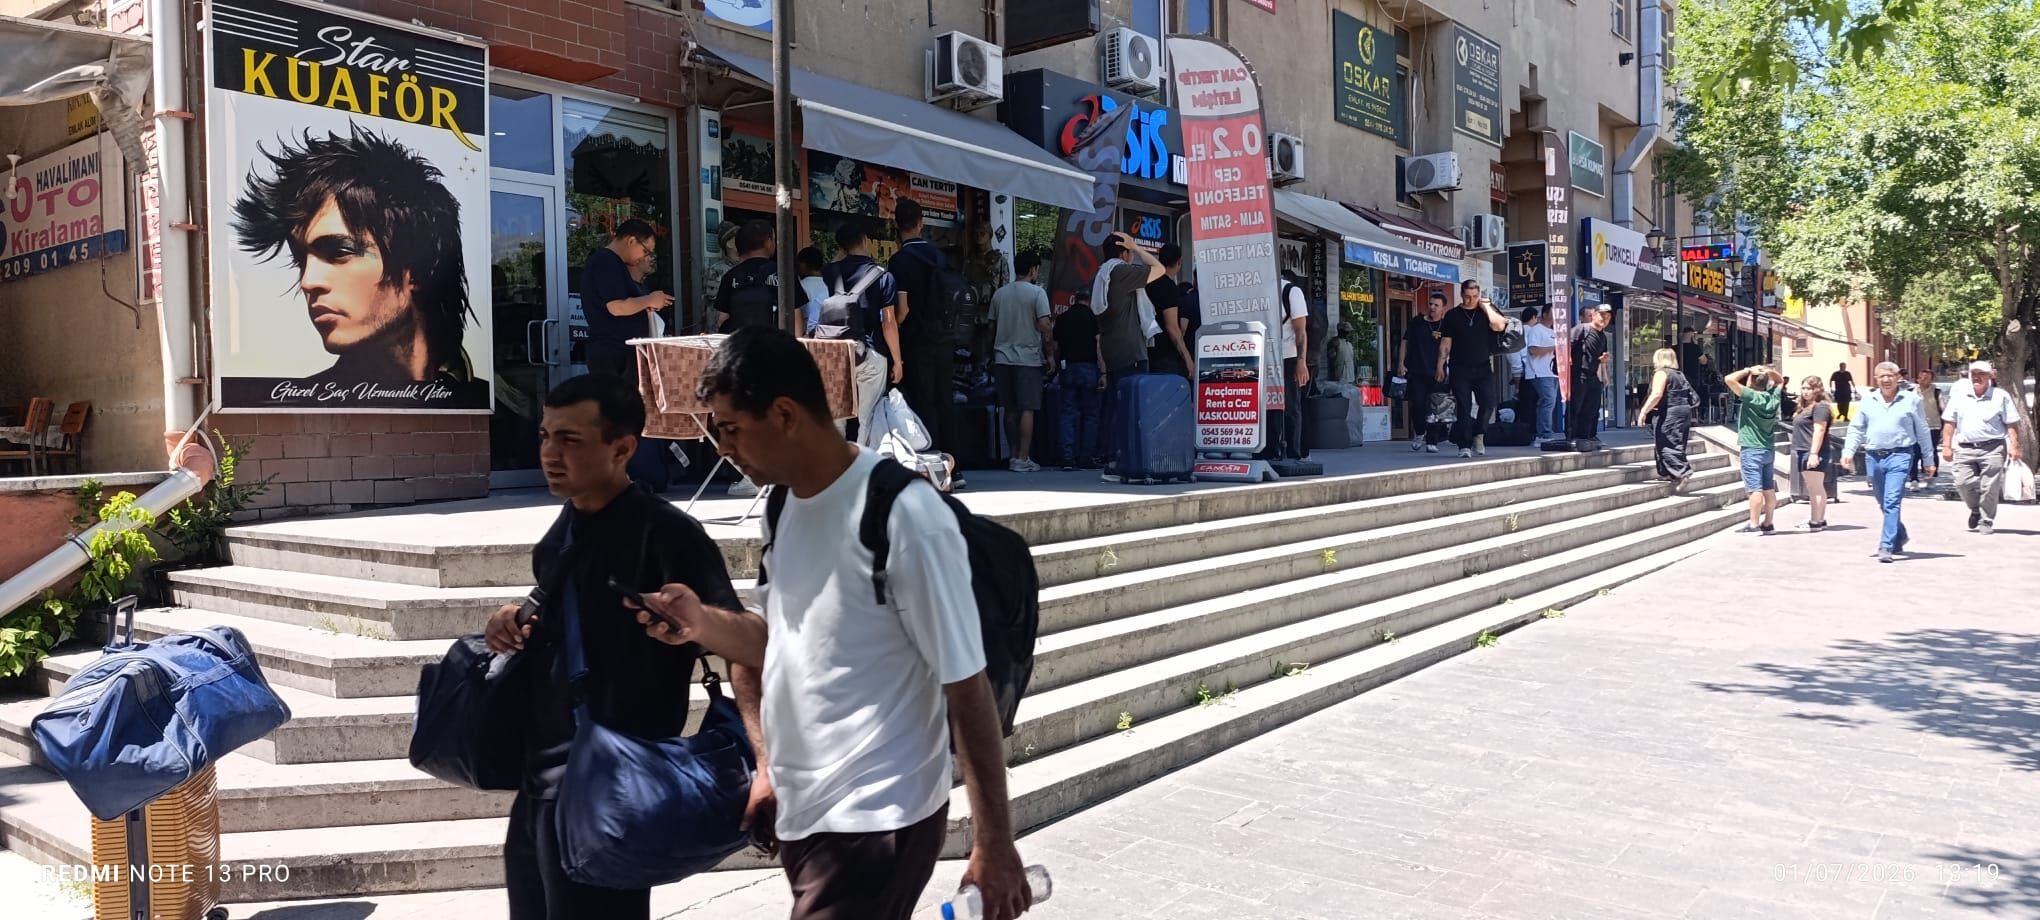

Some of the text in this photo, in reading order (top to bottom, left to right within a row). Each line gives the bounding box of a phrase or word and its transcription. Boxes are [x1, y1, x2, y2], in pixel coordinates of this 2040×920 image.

[294, 26, 411, 74] Star
[1469, 42, 1497, 69] OSKAR
[1343, 61, 1390, 99] OSKAR
[241, 47, 481, 152] KUAFÖR
[36, 151, 99, 193] HAVALİMANI
[911, 177, 928, 189] CAN
[11, 214, 101, 256] Kiralama
[4, 243, 89, 278] 209 01 45
[1373, 250, 1400, 269] KIŞLA
[1404, 257, 1438, 276] TİCARET
[1604, 243, 1637, 267] TURKCELL
[271, 381, 318, 402] Güzel
[318, 382, 350, 401] Saç
[352, 382, 418, 400] Uzmanlık
[1204, 386, 1253, 398] Araçlarımız
[1206, 400, 1226, 408] Rent
[1235, 399, 1251, 408] Car
[1199, 411, 1257, 421] KASKOLUDUR
[1201, 427, 1254, 436] 0543 569 94 22
[1203, 437, 1220, 445] 0541
[1233, 437, 1241, 445] 14
